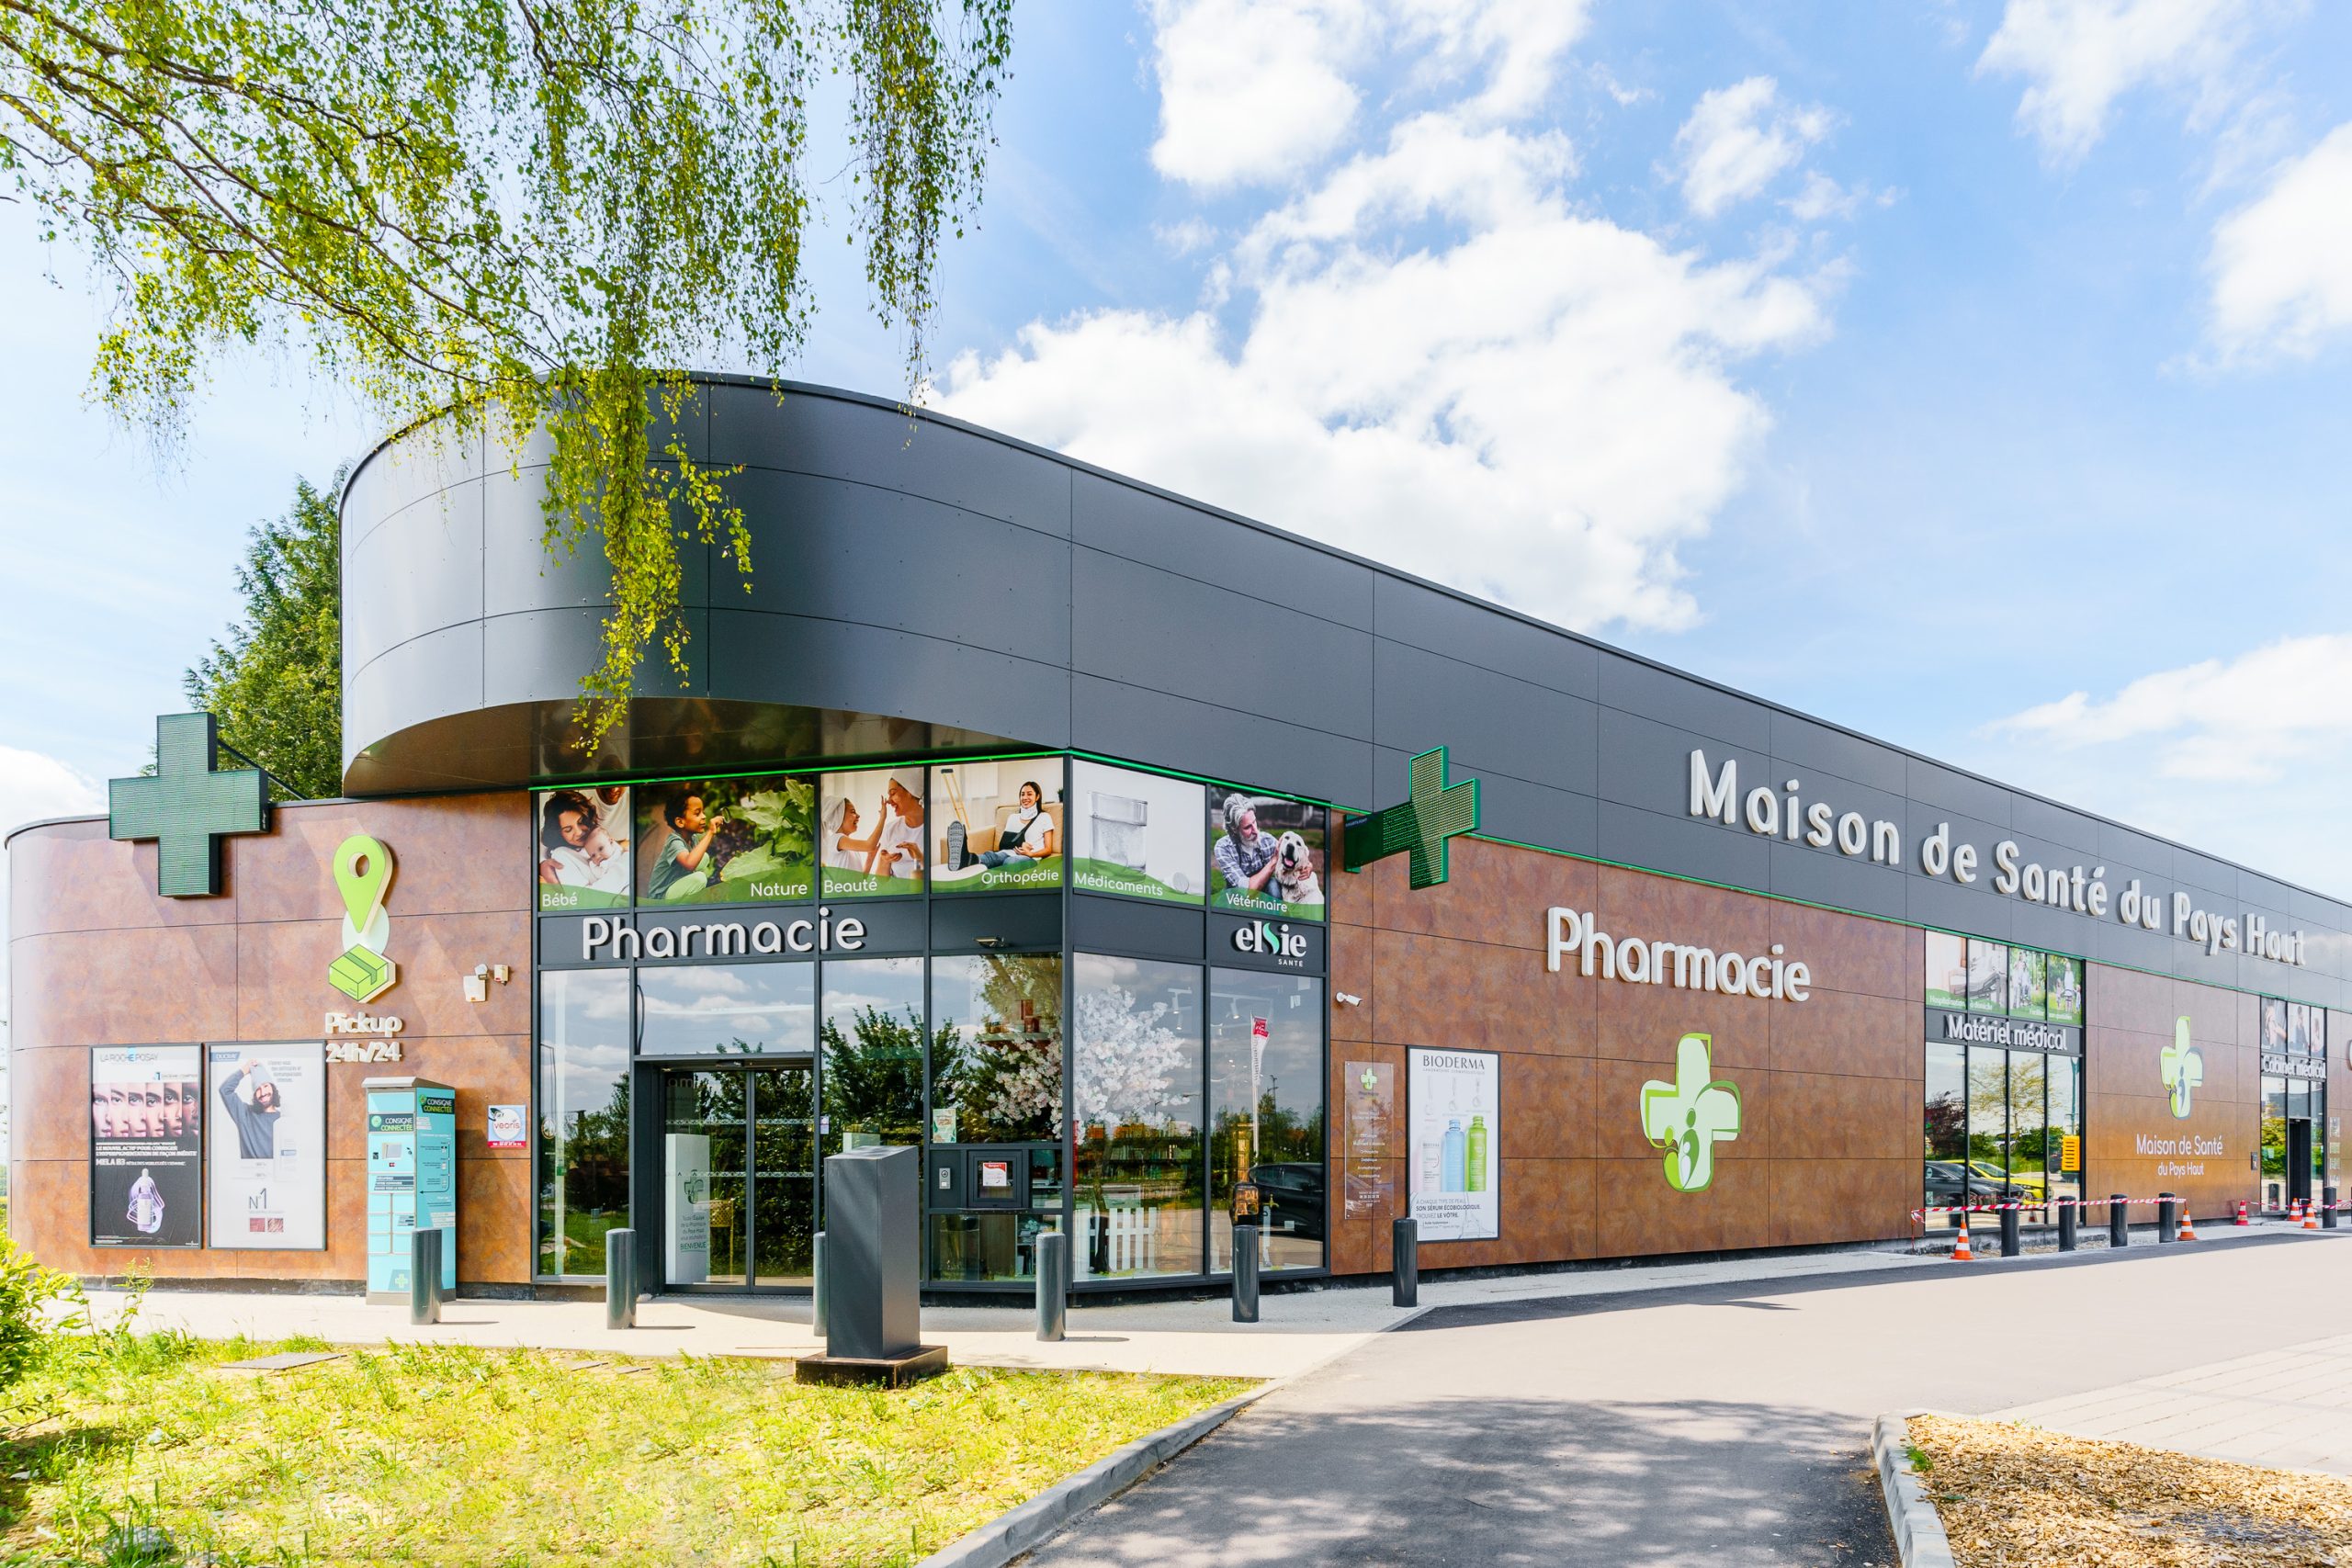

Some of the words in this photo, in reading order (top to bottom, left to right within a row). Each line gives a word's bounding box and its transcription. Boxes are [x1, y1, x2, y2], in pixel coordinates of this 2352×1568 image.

[1690, 749, 1900, 865] Maison
[1922, 821, 1978, 884] de
[1995, 840, 2109, 917] Santé
[2120, 878, 2161, 931] du
[2173, 891, 2238, 956] Pays
[2245, 912, 2306, 965] Haut
[823, 877, 878, 894] Beauté
[981, 870, 1059, 885] Orthopédie
[1074, 872, 1163, 897] Médicaments
[542, 892, 579, 908] Bébé
[751, 882, 808, 897] Nature
[1226, 892, 1288, 913] Vétérinaire
[582, 907, 865, 961] Pharmacie
[1547, 906, 1812, 1003] Pharmacie
[324, 1010, 403, 1038] Pickup
[1948, 1013, 2011, 1045] Matériel
[2014, 1022, 2068, 1051] médical
[325, 1041, 402, 1063] 24h/24
[1423, 1055, 1486, 1070] BIODERMA
[2263, 1055, 2297, 1076] Cabinet
[2297, 1058, 2326, 1079] médical
[424, 1105, 453, 1113] CONNECTÉE
[426, 1098, 452, 1107] CONSIGNE
[385, 1117, 413, 1125] CONSIGNE
[2136, 1134, 2176, 1155] Maison
[2178, 1135, 2192, 1156] de
[2194, 1134, 2223, 1156] Santé
[2158, 1162, 2167, 1176] du
[2169, 1161, 2186, 1179] Pays
[2187, 1161, 2204, 1176] Haut
